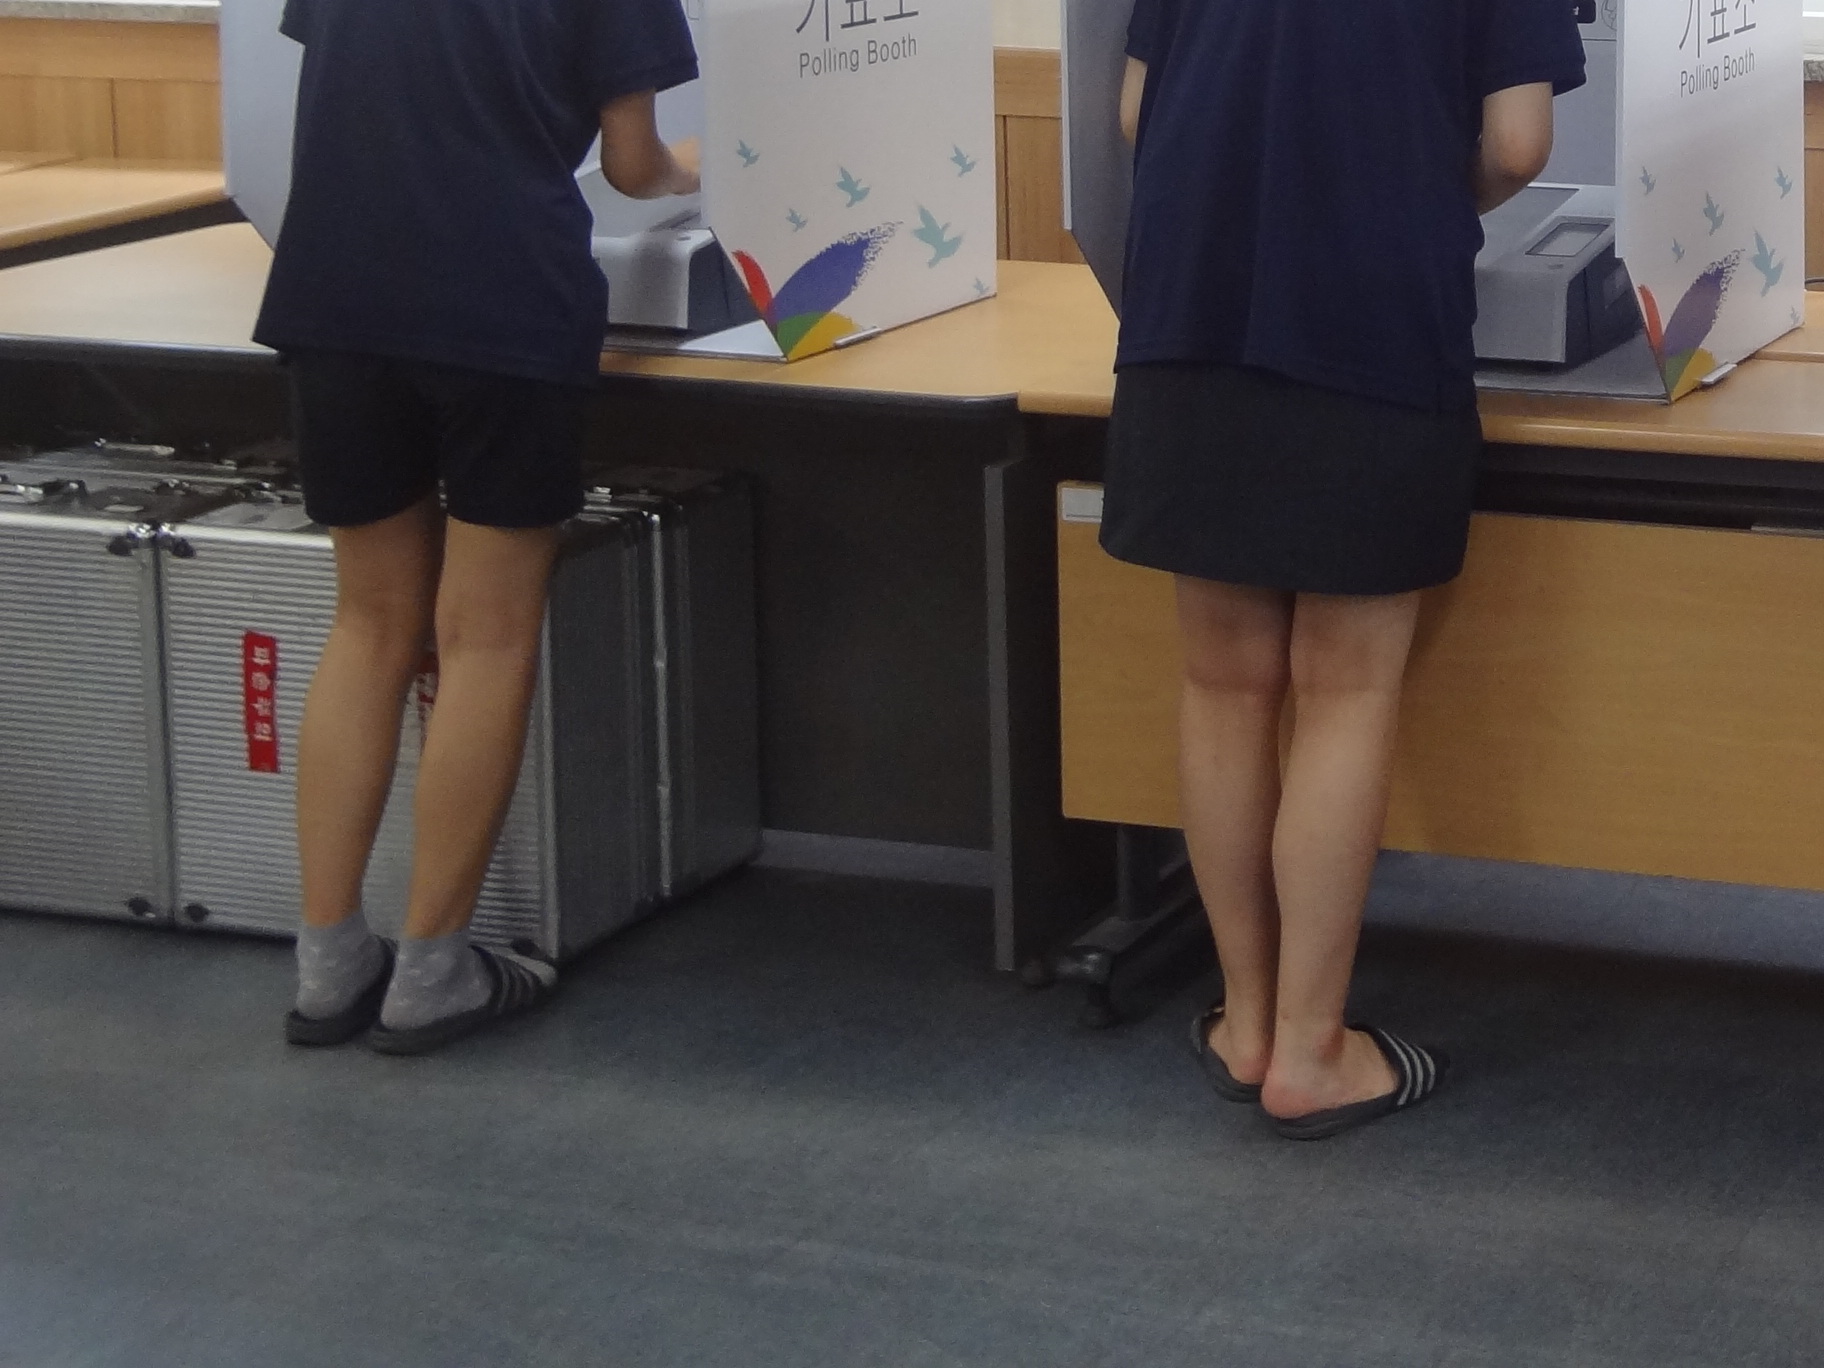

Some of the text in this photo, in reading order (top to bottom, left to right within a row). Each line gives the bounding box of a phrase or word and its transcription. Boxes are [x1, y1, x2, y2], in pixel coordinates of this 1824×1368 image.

[799, 33, 917, 78] Polling Booth
[1680, 47, 1755, 98] Polling Booth
